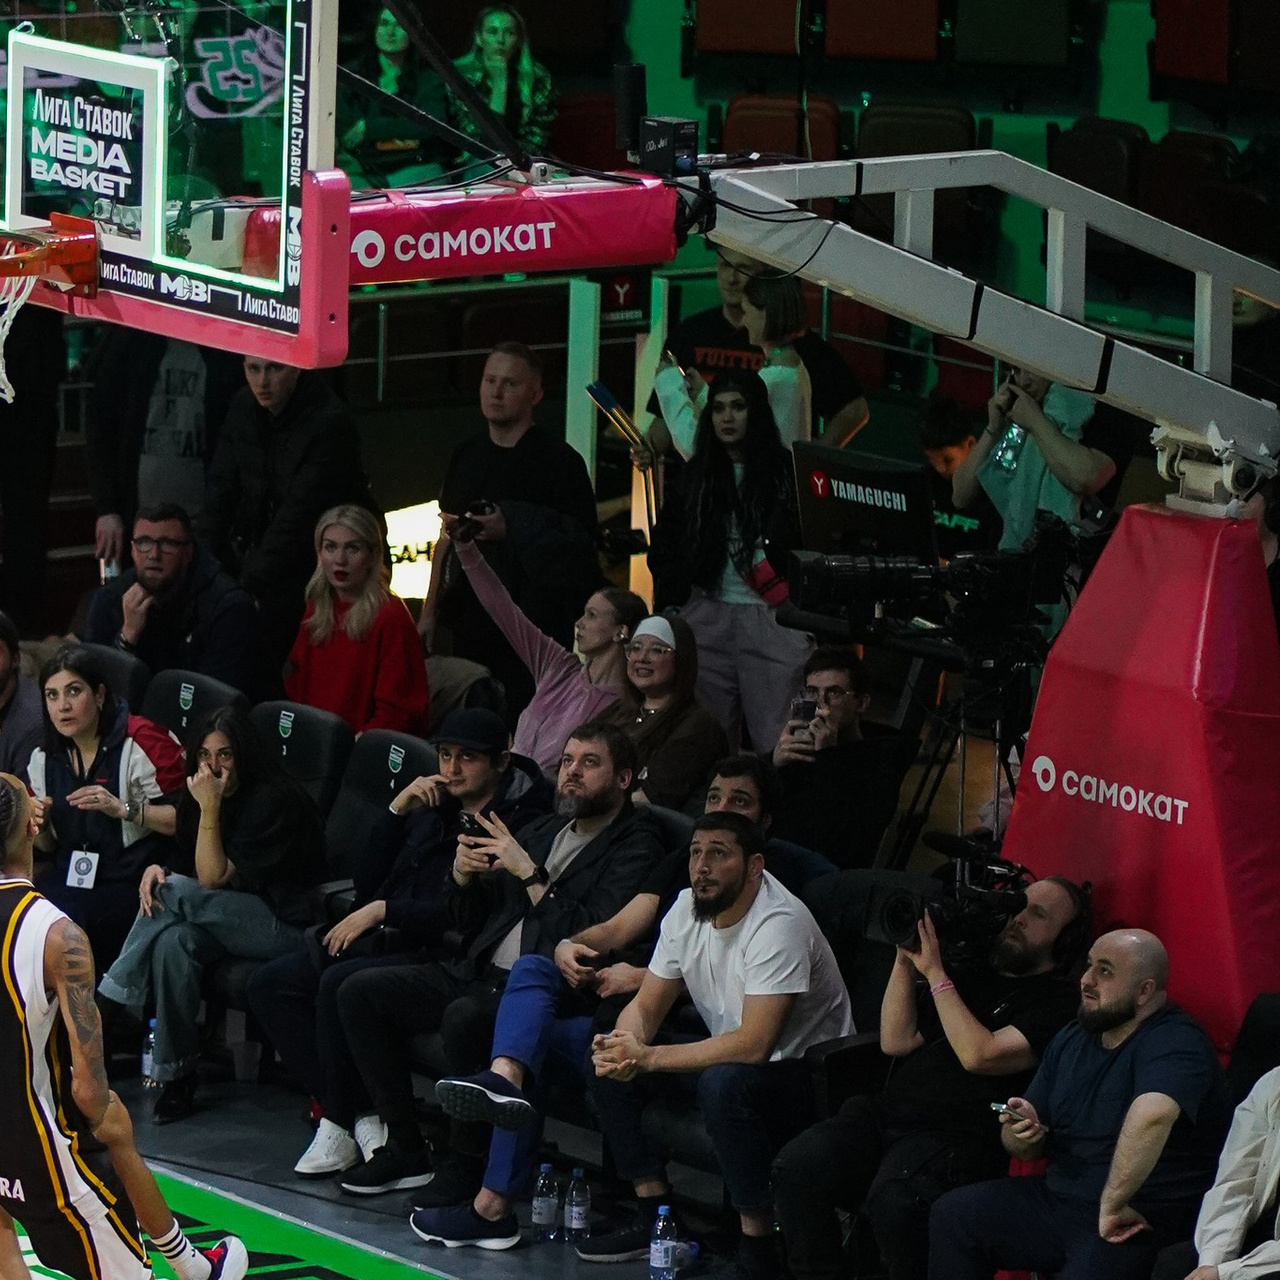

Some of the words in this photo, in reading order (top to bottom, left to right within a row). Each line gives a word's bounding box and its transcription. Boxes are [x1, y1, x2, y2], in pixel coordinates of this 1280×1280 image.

[73, 96, 133, 140] СТАВОК
[31, 126, 132, 174] MEDIA
[30, 158, 132, 198] BASKET
[394, 221, 556, 261] самокат
[269, 300, 300, 324] СТАВО
[830, 478, 908, 512] YAMAGUCHI
[1062, 770, 1189, 825] самокат
